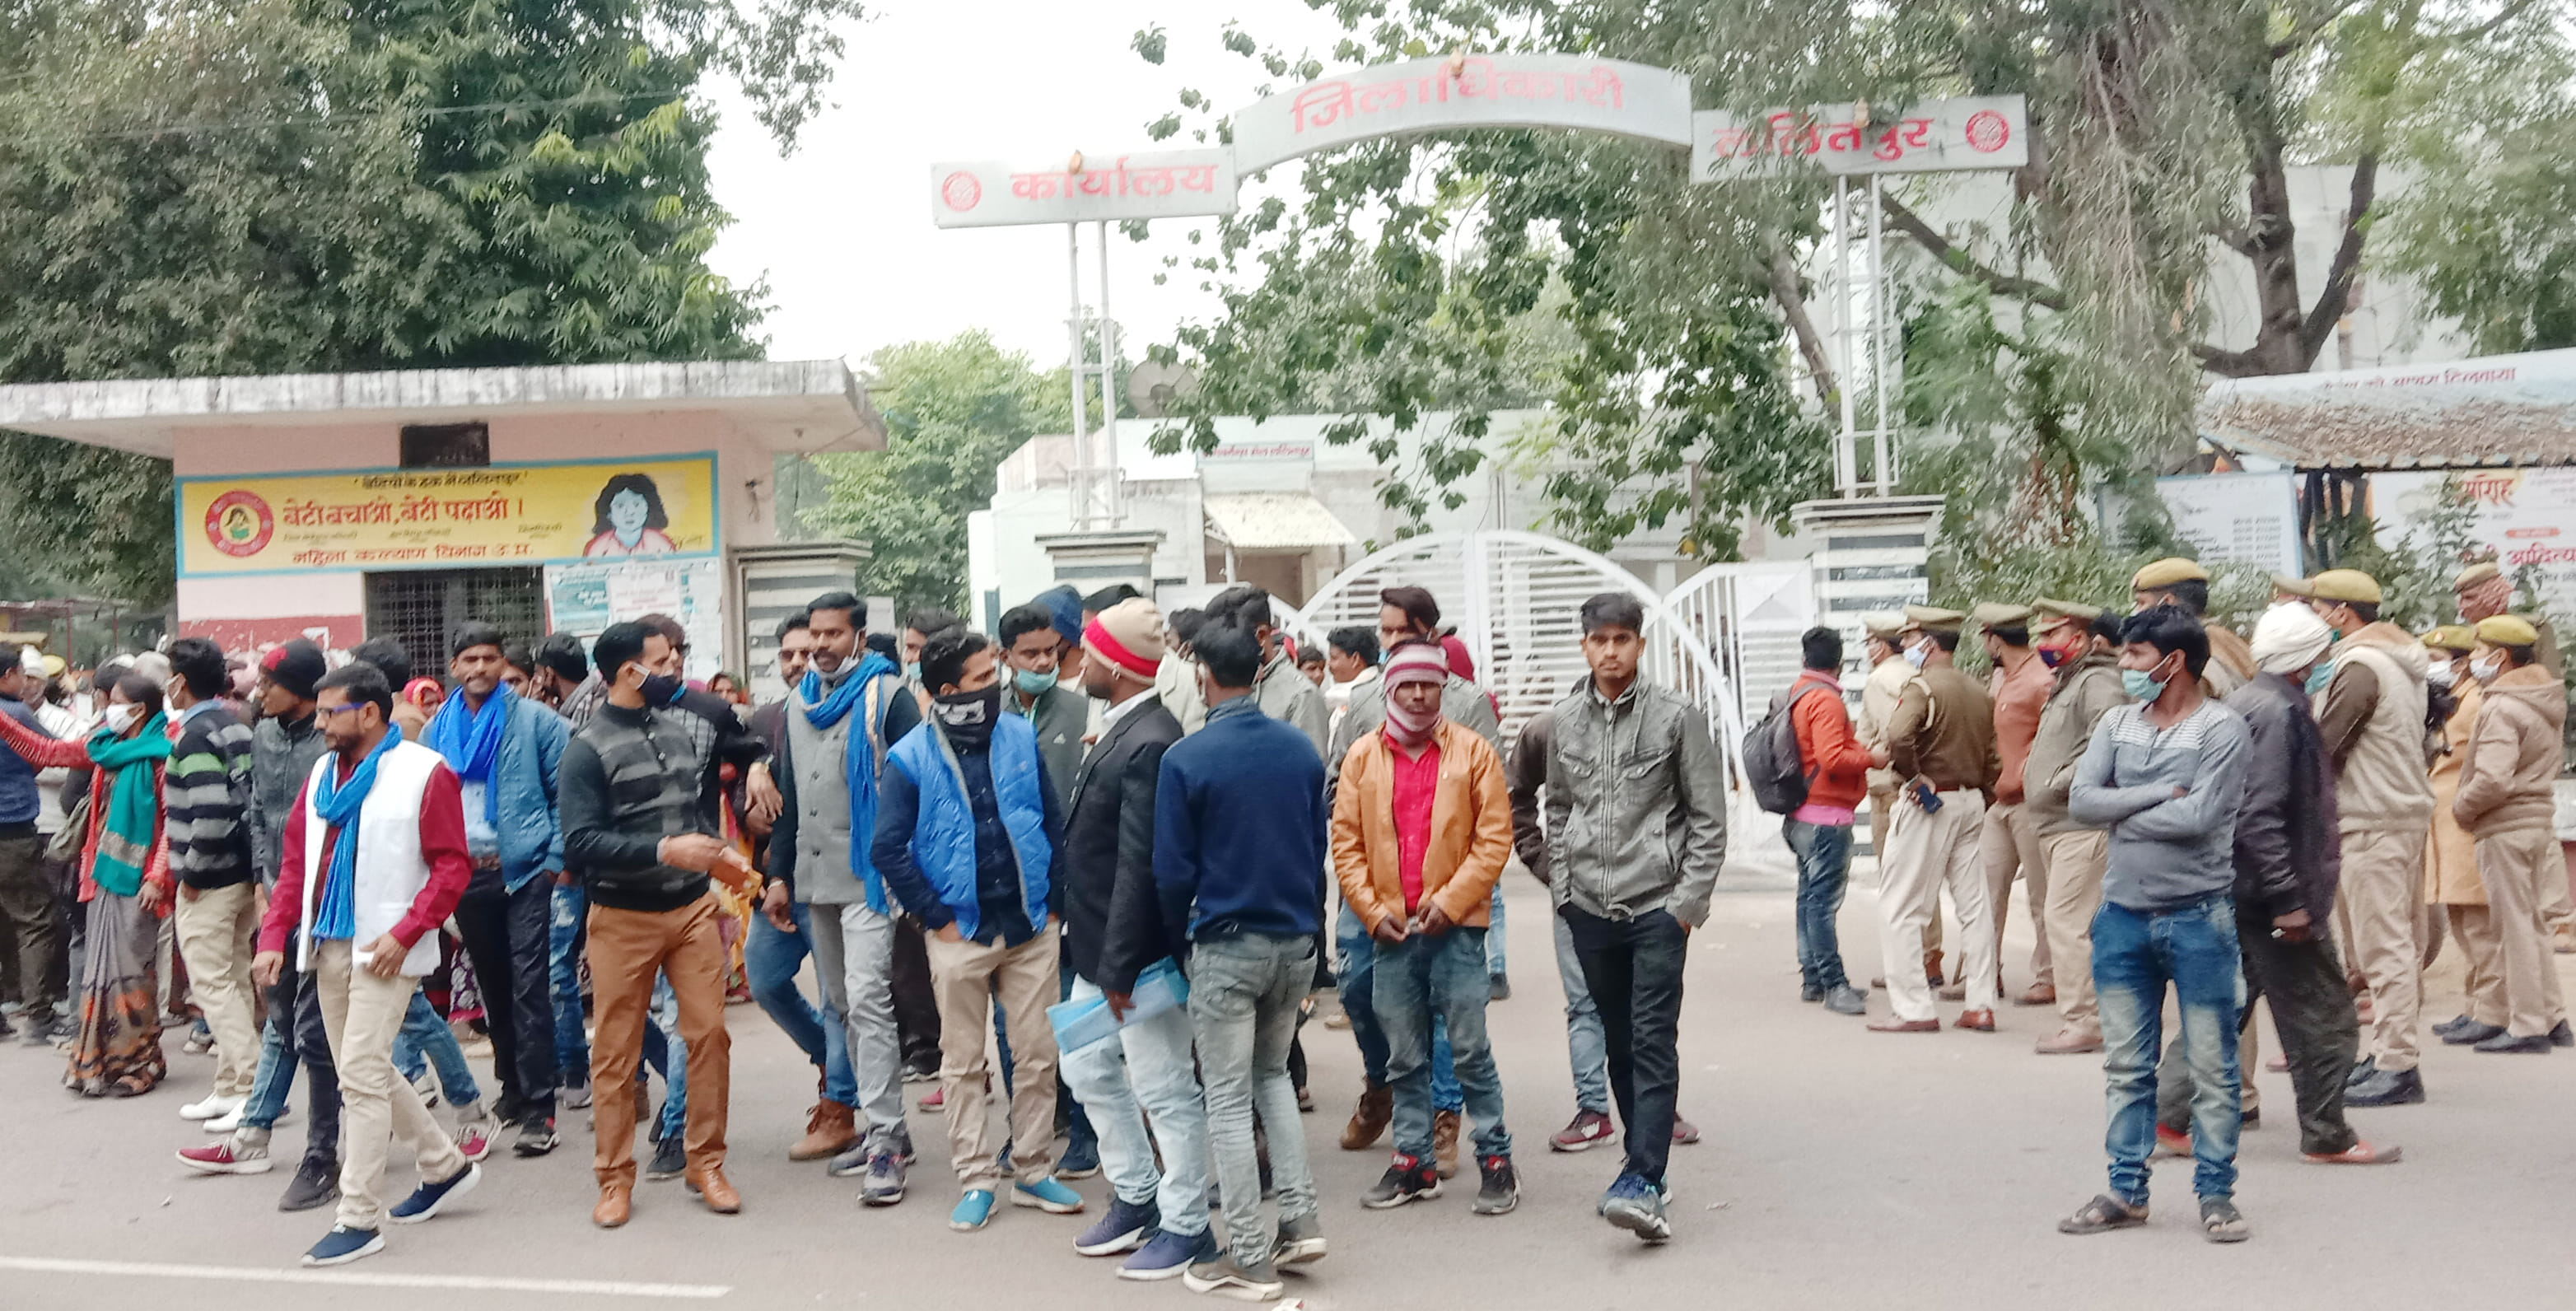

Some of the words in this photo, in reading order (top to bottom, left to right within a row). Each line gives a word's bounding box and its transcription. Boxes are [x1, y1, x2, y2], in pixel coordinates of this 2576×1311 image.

[1010, 156, 1219, 201] कार्यालय
[1291, 58, 1625, 133] जिलाधिकारी
[282, 497, 324, 526] बेटी
[400, 494, 439, 522] बेटी
[292, 548, 347, 567] महिला
[354, 547, 427, 561] कल्याण
[434, 544, 488, 559] विभाग
